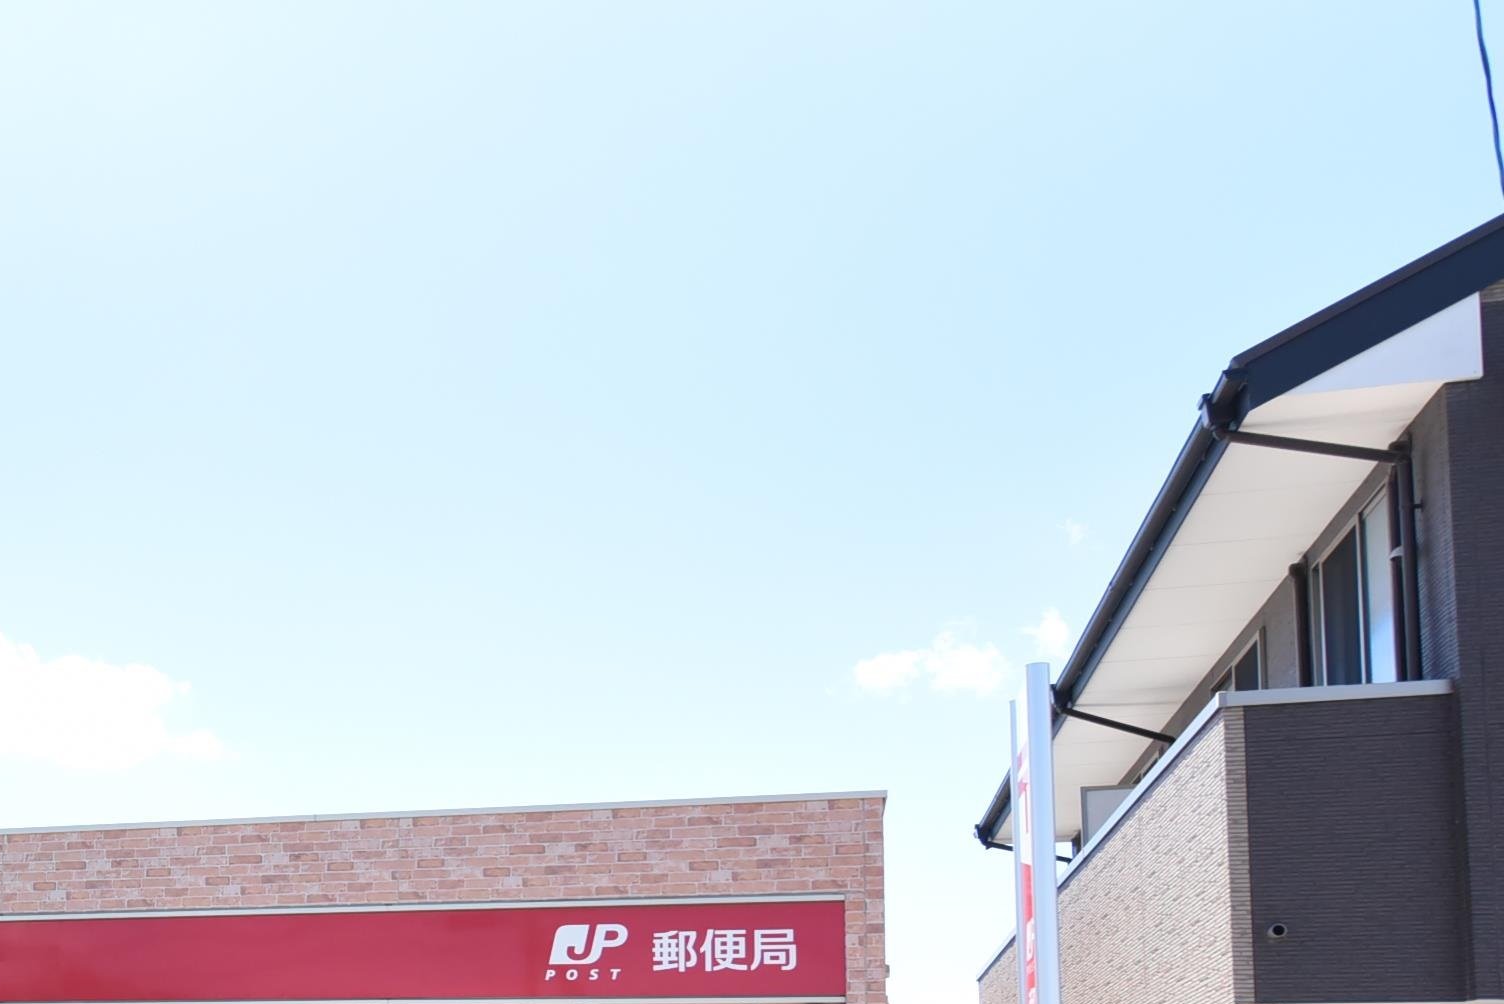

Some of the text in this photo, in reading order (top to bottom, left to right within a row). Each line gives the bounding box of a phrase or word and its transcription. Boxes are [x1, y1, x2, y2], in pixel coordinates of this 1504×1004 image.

[549, 923, 628, 965] JP
[652, 928, 797, 973] 郵便局
[544, 968, 622, 981] POST
